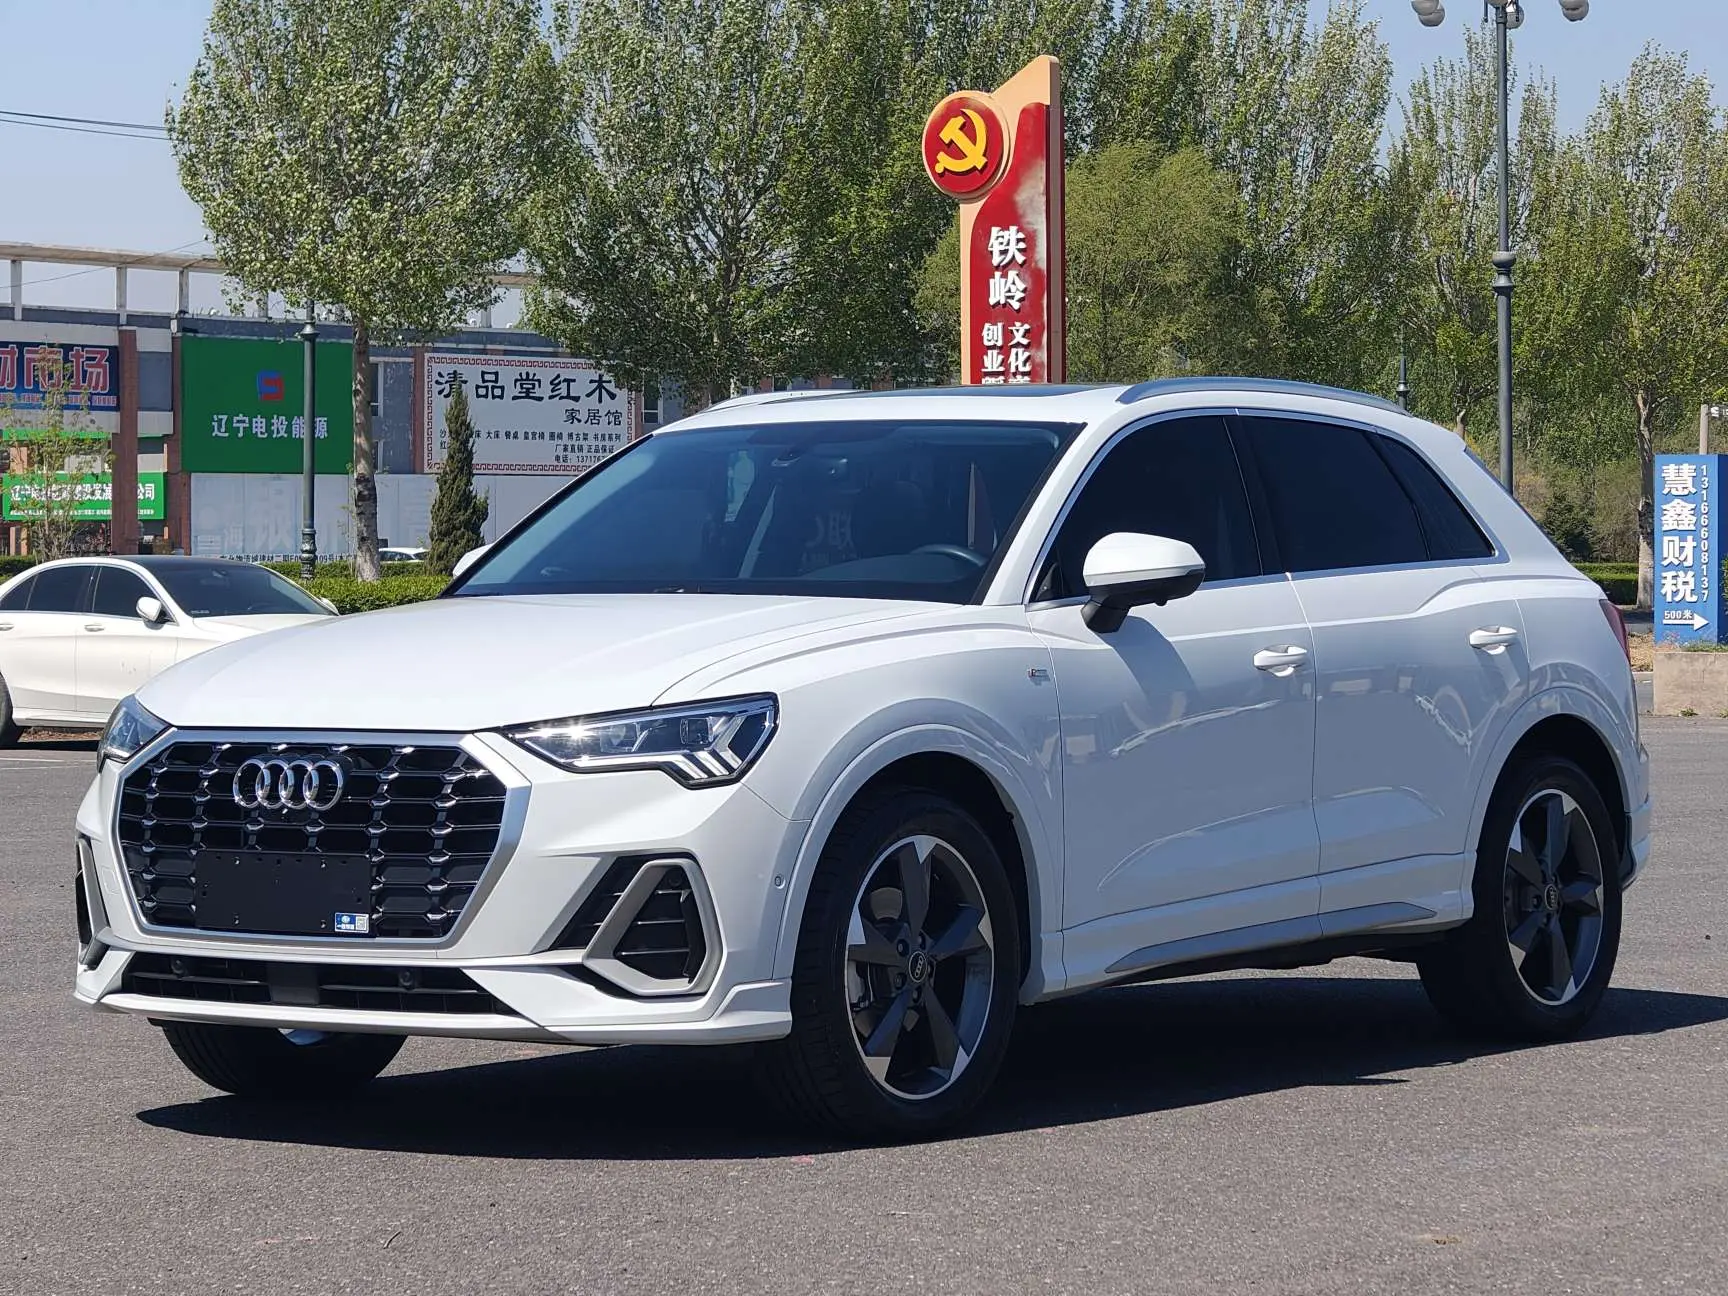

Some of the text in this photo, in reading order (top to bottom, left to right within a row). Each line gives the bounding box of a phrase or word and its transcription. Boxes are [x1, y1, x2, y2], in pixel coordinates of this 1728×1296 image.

[988, 226, 1027, 311] 铁岭
[435, 370, 618, 404] 清品堂红木
[212, 414, 328, 439] 辽宁电投能源
[563, 408, 623, 426] 家居馆
[486, 430, 500, 440] 大床
[555, 444, 583, 453] 厂家直销
[1661, 464, 1698, 603] 慧鑫财税
[1700, 465, 1709, 602] 13166608137
[1664, 609, 1692, 619] 500米
